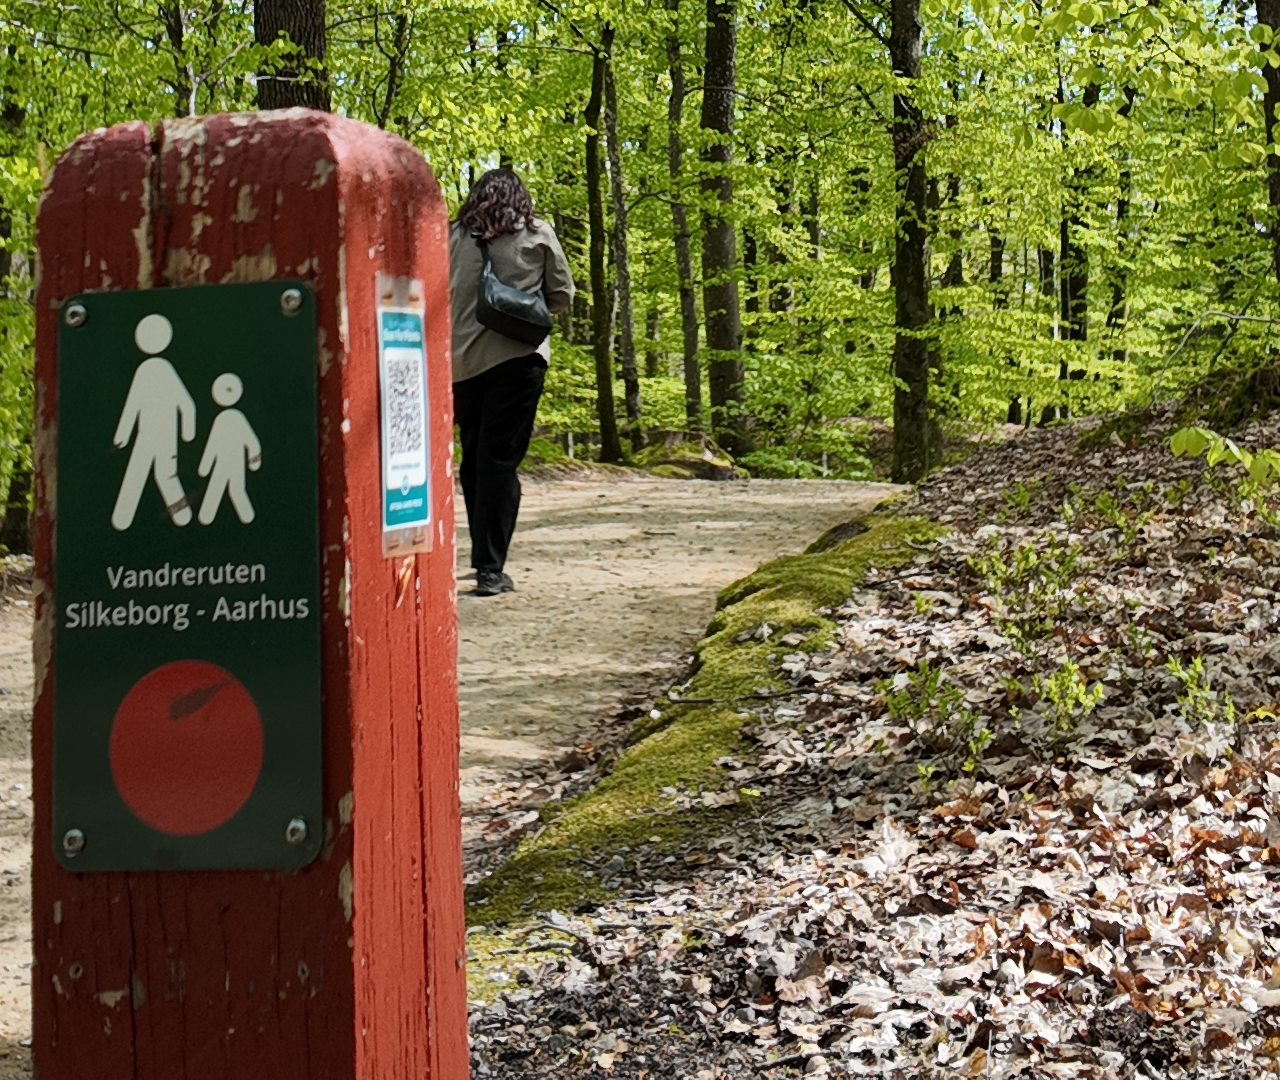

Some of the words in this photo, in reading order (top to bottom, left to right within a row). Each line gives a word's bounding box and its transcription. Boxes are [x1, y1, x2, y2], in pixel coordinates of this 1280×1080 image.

[106, 562, 266, 589] Vandreruten
[65, 599, 190, 631] Silkeborg
[211, 593, 310, 622] Aarhus
